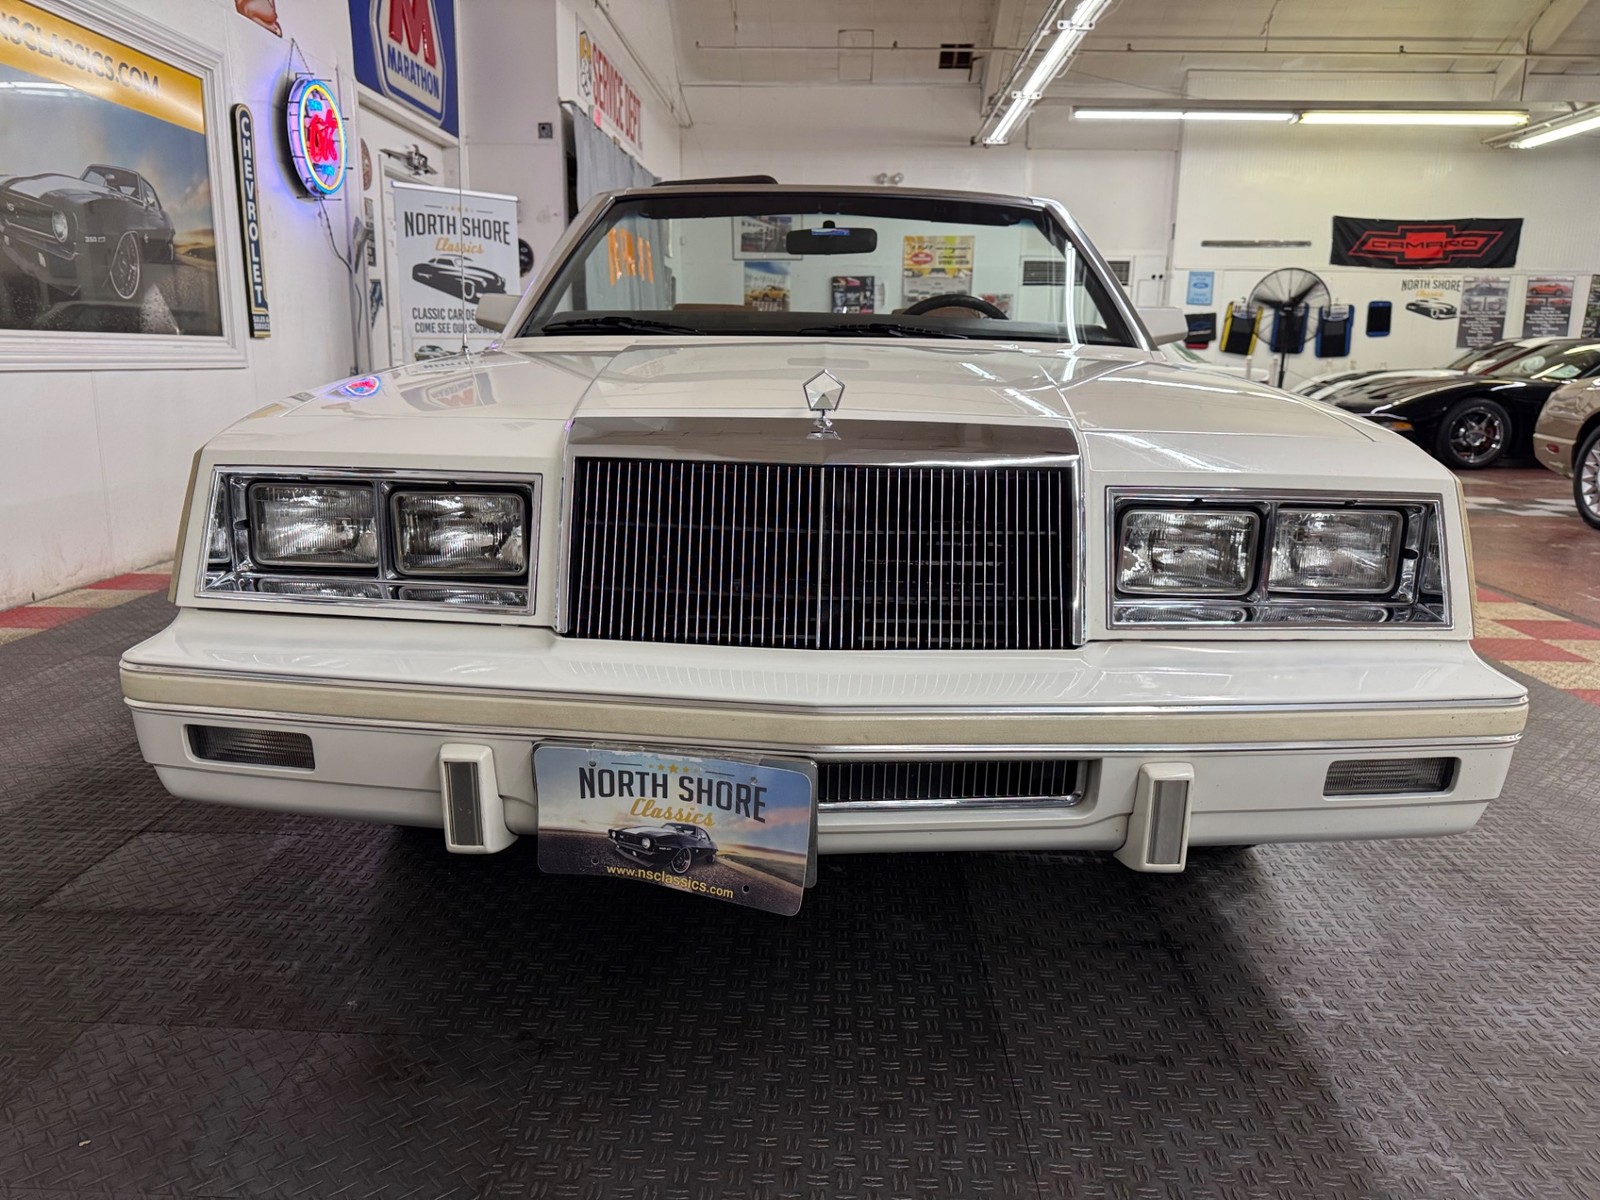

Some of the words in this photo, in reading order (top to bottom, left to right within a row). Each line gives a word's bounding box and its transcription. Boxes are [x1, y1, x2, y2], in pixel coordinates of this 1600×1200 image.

[387, 43, 440, 99] MARATHON
[592, 42, 624, 131] SERVICE
[241, 117, 263, 304] CHEVROLET
[404, 211, 457, 238] NORTH
[462, 217, 511, 245] SHORE
[434, 236, 485, 254] Classics
[1371, 240, 1478, 249] CAMARO
[1401, 279, 1431, 291] NORTH
[1432, 280, 1462, 292] SHORE
[412, 307, 446, 320] CLASSIC
[448, 308, 464, 320] CAR
[415, 322, 437, 334] COME
[438, 322, 450, 334] SEE
[578, 767, 669, 799] NORTH
[678, 776, 768, 823] SHORE
[629, 797, 715, 828] Classics
[606, 865, 734, 898] www.nsclassics.com
